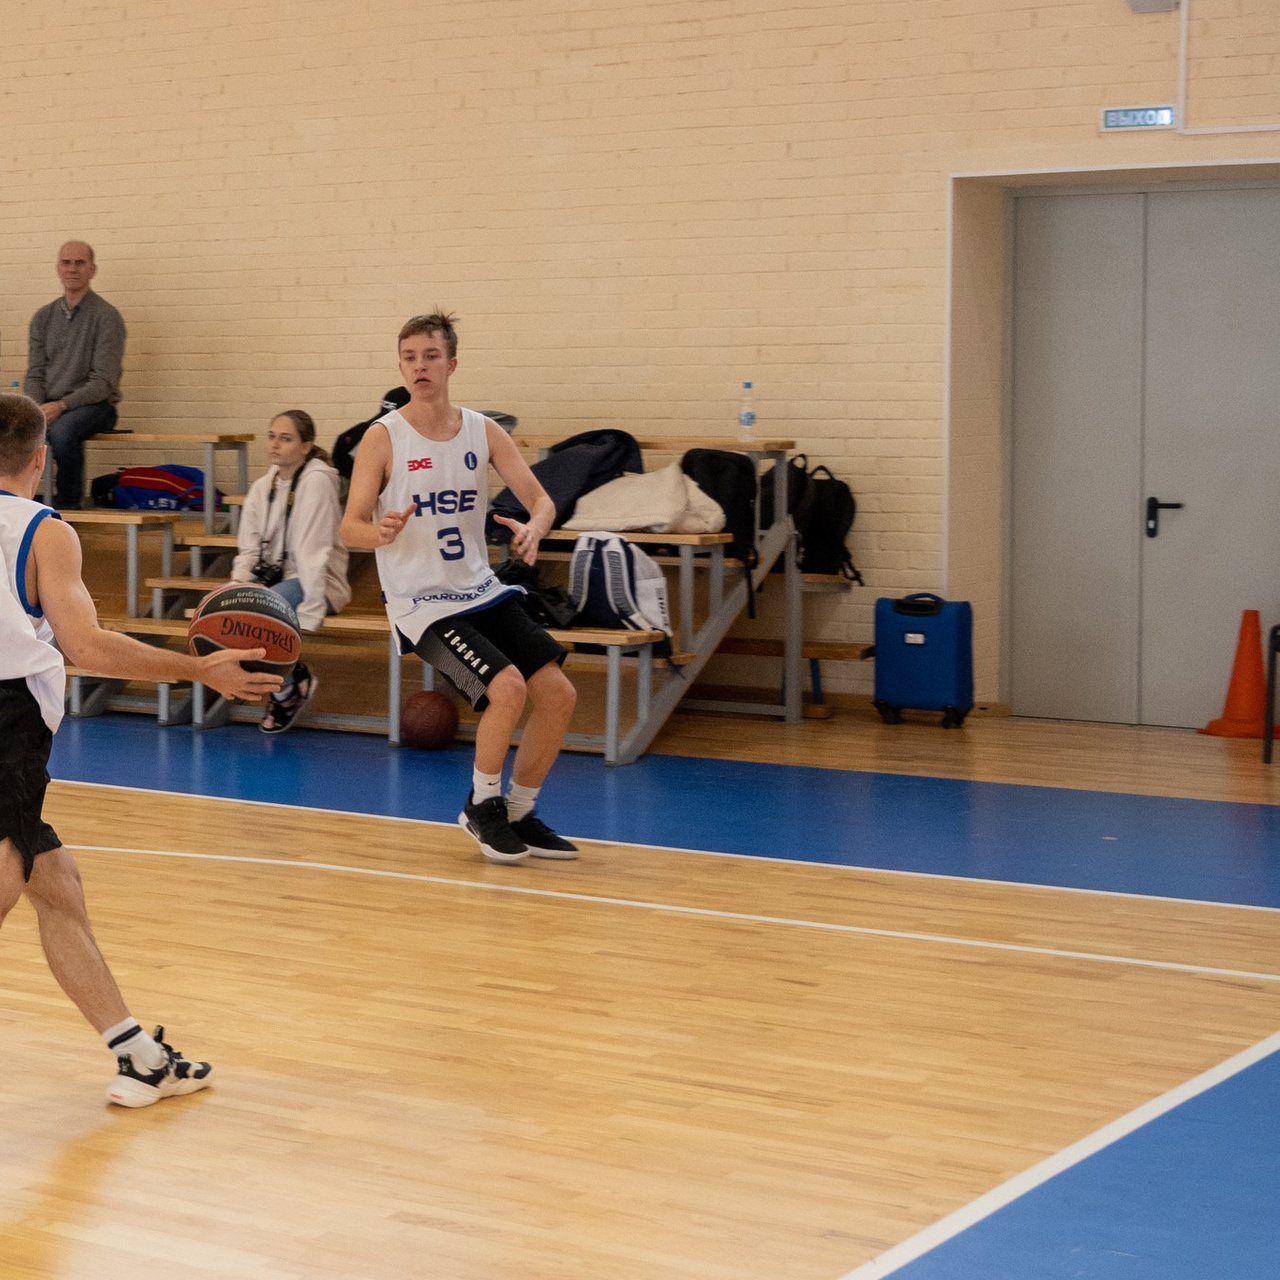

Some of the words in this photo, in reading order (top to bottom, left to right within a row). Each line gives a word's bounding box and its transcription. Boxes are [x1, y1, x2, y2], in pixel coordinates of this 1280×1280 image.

[412, 489, 478, 517] HSE
[437, 527, 465, 561] 3
[477, 579, 493, 593] CUP
[221, 617, 296, 653] SPALDING
